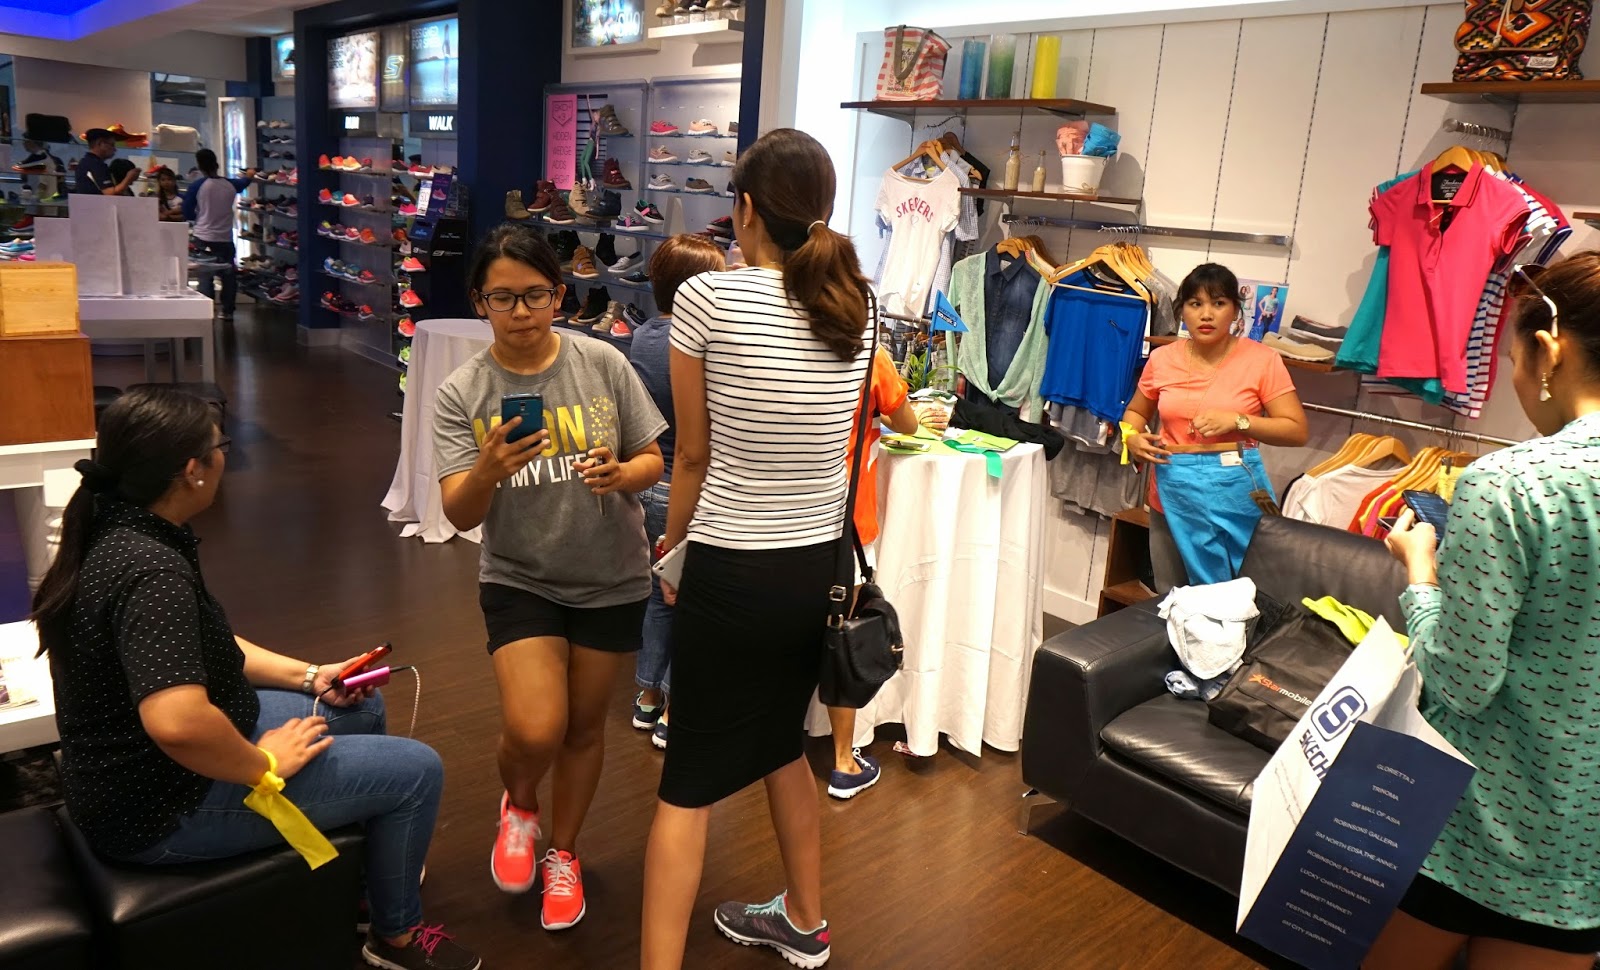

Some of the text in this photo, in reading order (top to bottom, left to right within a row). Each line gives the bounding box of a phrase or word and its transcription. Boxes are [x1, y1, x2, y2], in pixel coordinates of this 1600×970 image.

[428, 115, 454, 131] WALK
[552, 146, 572, 156] WEDGE
[552, 160, 567, 170] ADDS
[896, 196, 934, 223] SKECERS
[473, 405, 587, 458] MON
[511, 460, 541, 488] MY
[1260, 678, 1313, 707] Starmobile
[1376, 763, 1410, 782] GLORIETTA
[1371, 784, 1399, 801] TRINOMA
[1350, 801, 1361, 809] SM
[1361, 804, 1375, 815] MALL
[1385, 815, 1400, 826] ASIA
[1333, 817, 1399, 848] ROBINSONS GALLERIA
[1315, 830, 1325, 840] SM
[1325, 836, 1347, 850] NORTH
[1376, 857, 1398, 870] ANNEX
[1306, 849, 1385, 889] ROBINSONS PLACE MANILA
[1300, 867, 1371, 904] LUCKY CHINATOWN MALL
[1285, 901, 1347, 935] FESTIVAL SUPERMALL
[1291, 924, 1305, 933] CITY
[1305, 931, 1333, 946] FAIRVIEW
